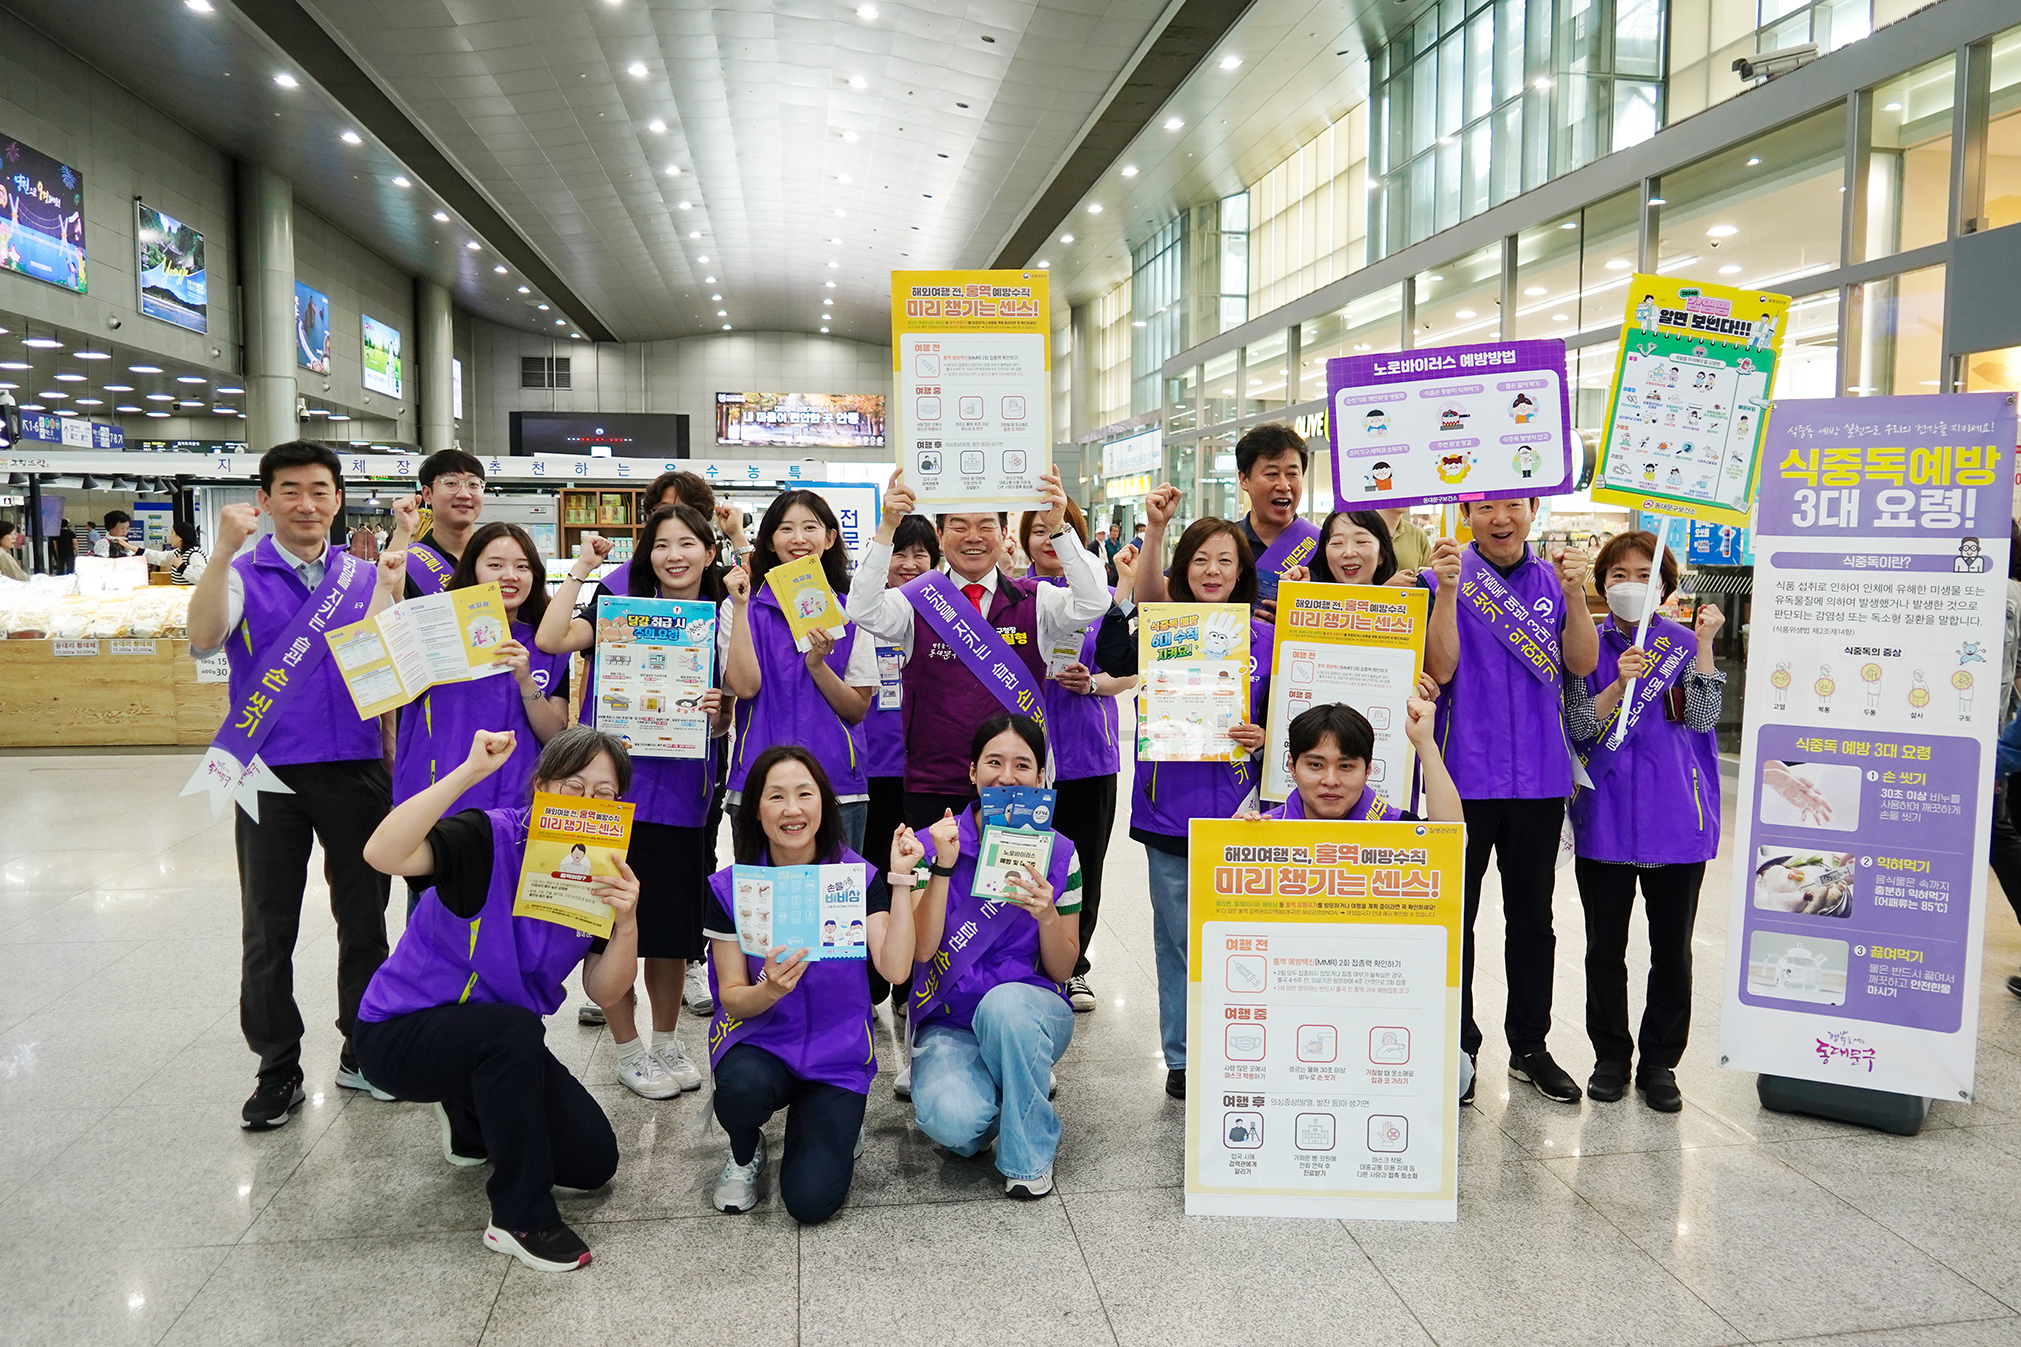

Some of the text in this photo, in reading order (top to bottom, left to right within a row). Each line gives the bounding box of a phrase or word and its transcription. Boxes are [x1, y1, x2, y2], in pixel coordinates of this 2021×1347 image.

[911, 284, 1031, 298] 해외여행 전, 홍역 예방수칙
[906, 299, 1040, 318] 미리 챙기는 센스!
[1658, 308, 1754, 338] 알면 보인다!!!
[1373, 349, 1517, 377] 노로바이러스 예방방법
[756, 411, 787, 423] 마음이
[789, 412, 821, 424] 편안한
[835, 412, 860, 425] 안동
[1295, 411, 1324, 438] OLIVE
[1787, 420, 1995, 439] 식중독 예방 실천으로 우리의 건강을 지키세요!
[488, 460, 631, 477] 추천하는
[1779, 445, 2002, 487] 식중독예방
[1654, 502, 1697, 515] 동대문구보건소
[1791, 488, 1977, 529] 3대 요령!
[1843, 555, 1912, 569] 식중독이란?
[336, 555, 357, 592] 건강을
[1775, 581, 1986, 597] 식품 섭취로 인하여 인체에 유해한 미생물 또는
[307, 588, 345, 634] 지키는
[1295, 599, 1407, 615] 해외여행 전, 홍역 예방수칙
[1476, 567, 1508, 599] 식중독
[1503, 595, 1530, 622] 예방
[1527, 619, 1552, 644] 3대
[1775, 595, 1978, 611] 유독물질에 의하여 발생했거나 발생한 것으로
[627, 614, 687, 629] 달걀 취급 시
[1150, 613, 1200, 632] 식중독 예방
[1289, 610, 1413, 634] 미리 챙기는 센스!
[1774, 609, 1983, 627] 판단되는 감염성 또는 독소형 질환을 말합니다.
[633, 628, 680, 641] 주의 요령
[1151, 626, 1199, 648] 6대 수칙
[1460, 581, 1559, 683] 손 씻기 익혀먹기
[1772, 625, 1855, 637] (식품위생법 제2조제14항)
[282, 636, 311, 668] 습관
[919, 583, 958, 624] 건강을
[952, 618, 992, 661] 지키는
[991, 661, 1020, 691] 습관
[1016, 689, 1035, 712] 손
[1156, 644, 1193, 661] 지켜요!
[1653, 636, 1672, 652] 손
[1844, 646, 1902, 657] 식중독의 증상
[1658, 645, 1689, 680] 식중독
[261, 667, 289, 693] 손
[1640, 676, 1665, 702] 예방
[234, 691, 274, 739] 씻기
[1772, 703, 1786, 711] 고열
[1817, 706, 1831, 714] 복통
[1863, 708, 1876, 717] 두통
[1910, 711, 1924, 720] 설사
[1957, 714, 1972, 722] 구토
[1795, 737, 1932, 761] 식중독 예방 3대 요령
[1882, 770, 1927, 786] 손 씻기
[1880, 788, 1961, 805] 30초 이상 비누를
[539, 816, 563, 831] 미리
[563, 819, 598, 834] 챙기는
[598, 822, 624, 838] 센스!
[1429, 827, 1458, 835] 질병관리청
[999, 857, 1012, 865] 예방
[1003, 849, 1036, 859] 노로바이러스
[1225, 843, 1428, 866] 해외여행 전, 홍역 예방수칙
[1876, 856, 1931, 874] 익혀먹기
[827, 881, 844, 893] 손을
[1215, 867, 1441, 899] 미리 챙기는 센스!
[1875, 874, 1950, 891] 음식물은 속까지
[1874, 885, 1949, 903] 충분히 익혀먹기
[933, 920, 979, 976] 습관 손
[1226, 938, 1268, 952] 여행 전
[1869, 944, 1924, 964] 끓여먹기
[1866, 985, 1898, 998] 마시기
[1224, 1008, 1267, 1021] 여행 중
[1816, 1038, 1876, 1072] 동대문구
[1223, 1095, 1265, 1108] 여행 후
